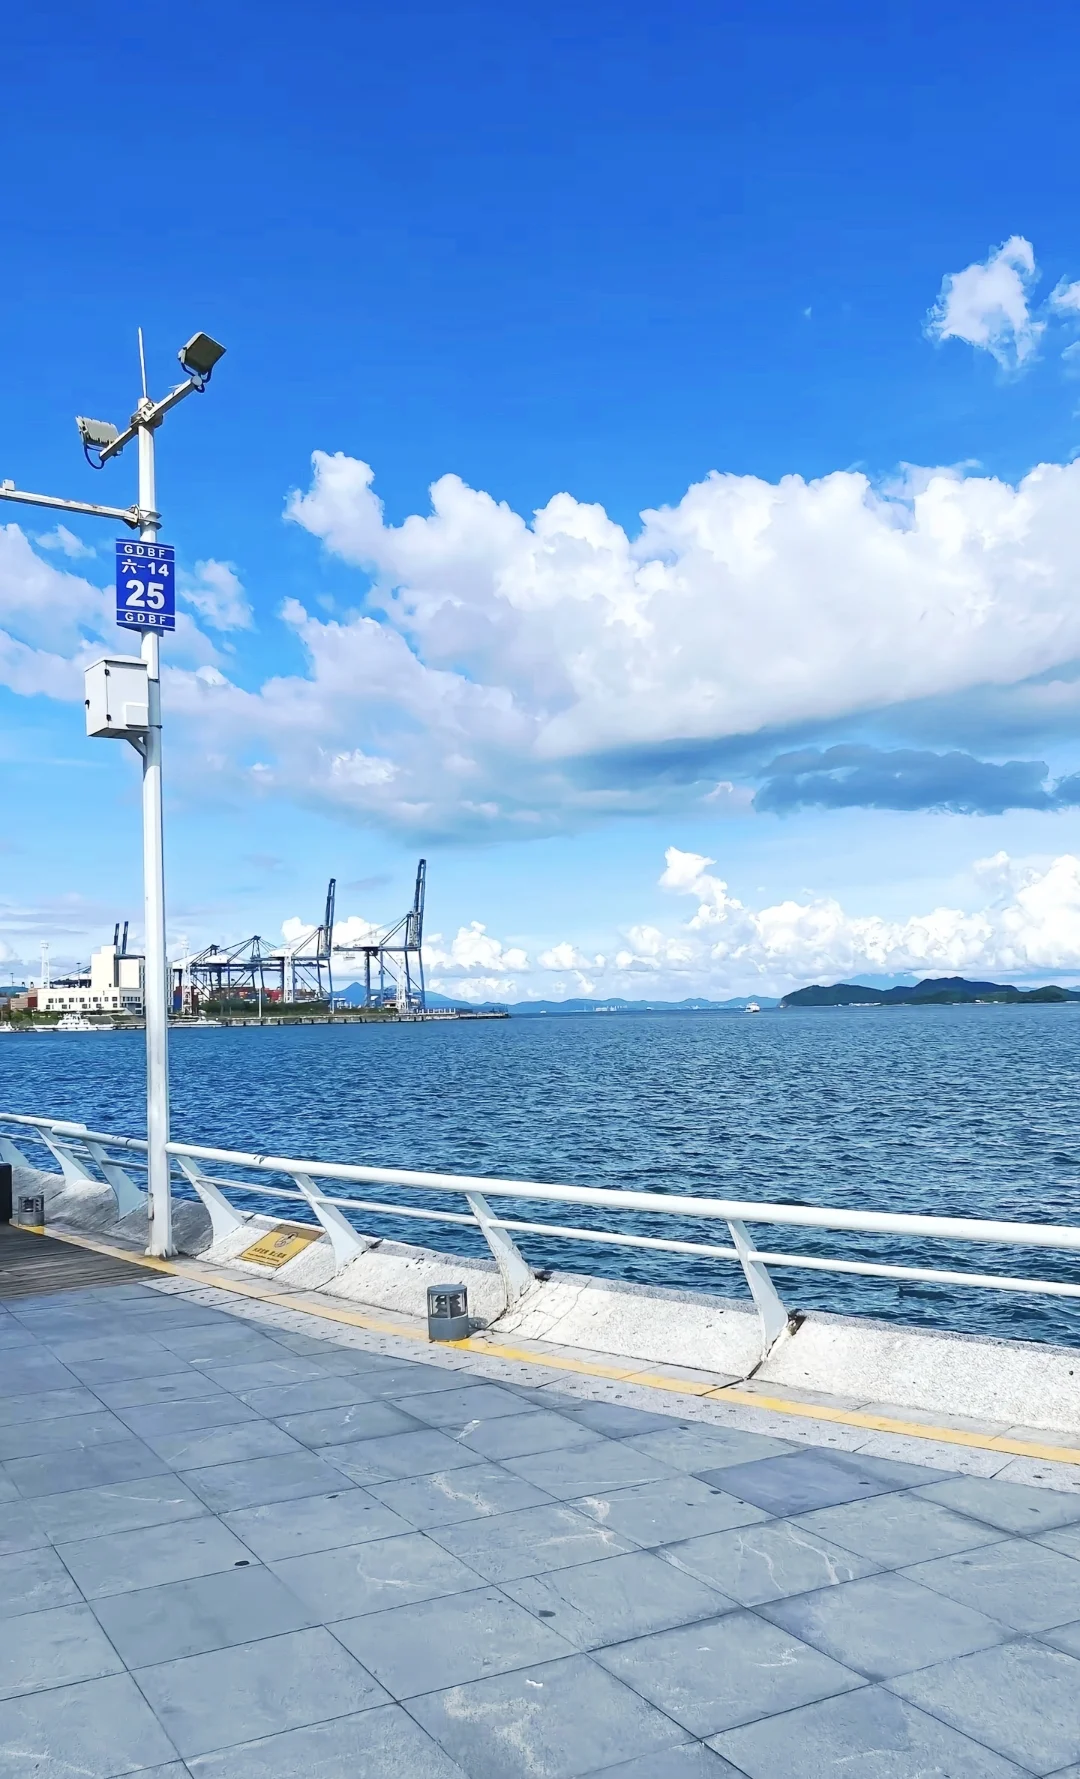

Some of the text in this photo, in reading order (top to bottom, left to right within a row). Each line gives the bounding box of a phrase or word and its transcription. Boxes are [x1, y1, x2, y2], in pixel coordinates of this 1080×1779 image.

[124, 544, 165, 558] GDBF
[125, 579, 165, 609] 25
[125, 612, 166, 624] GDBF
